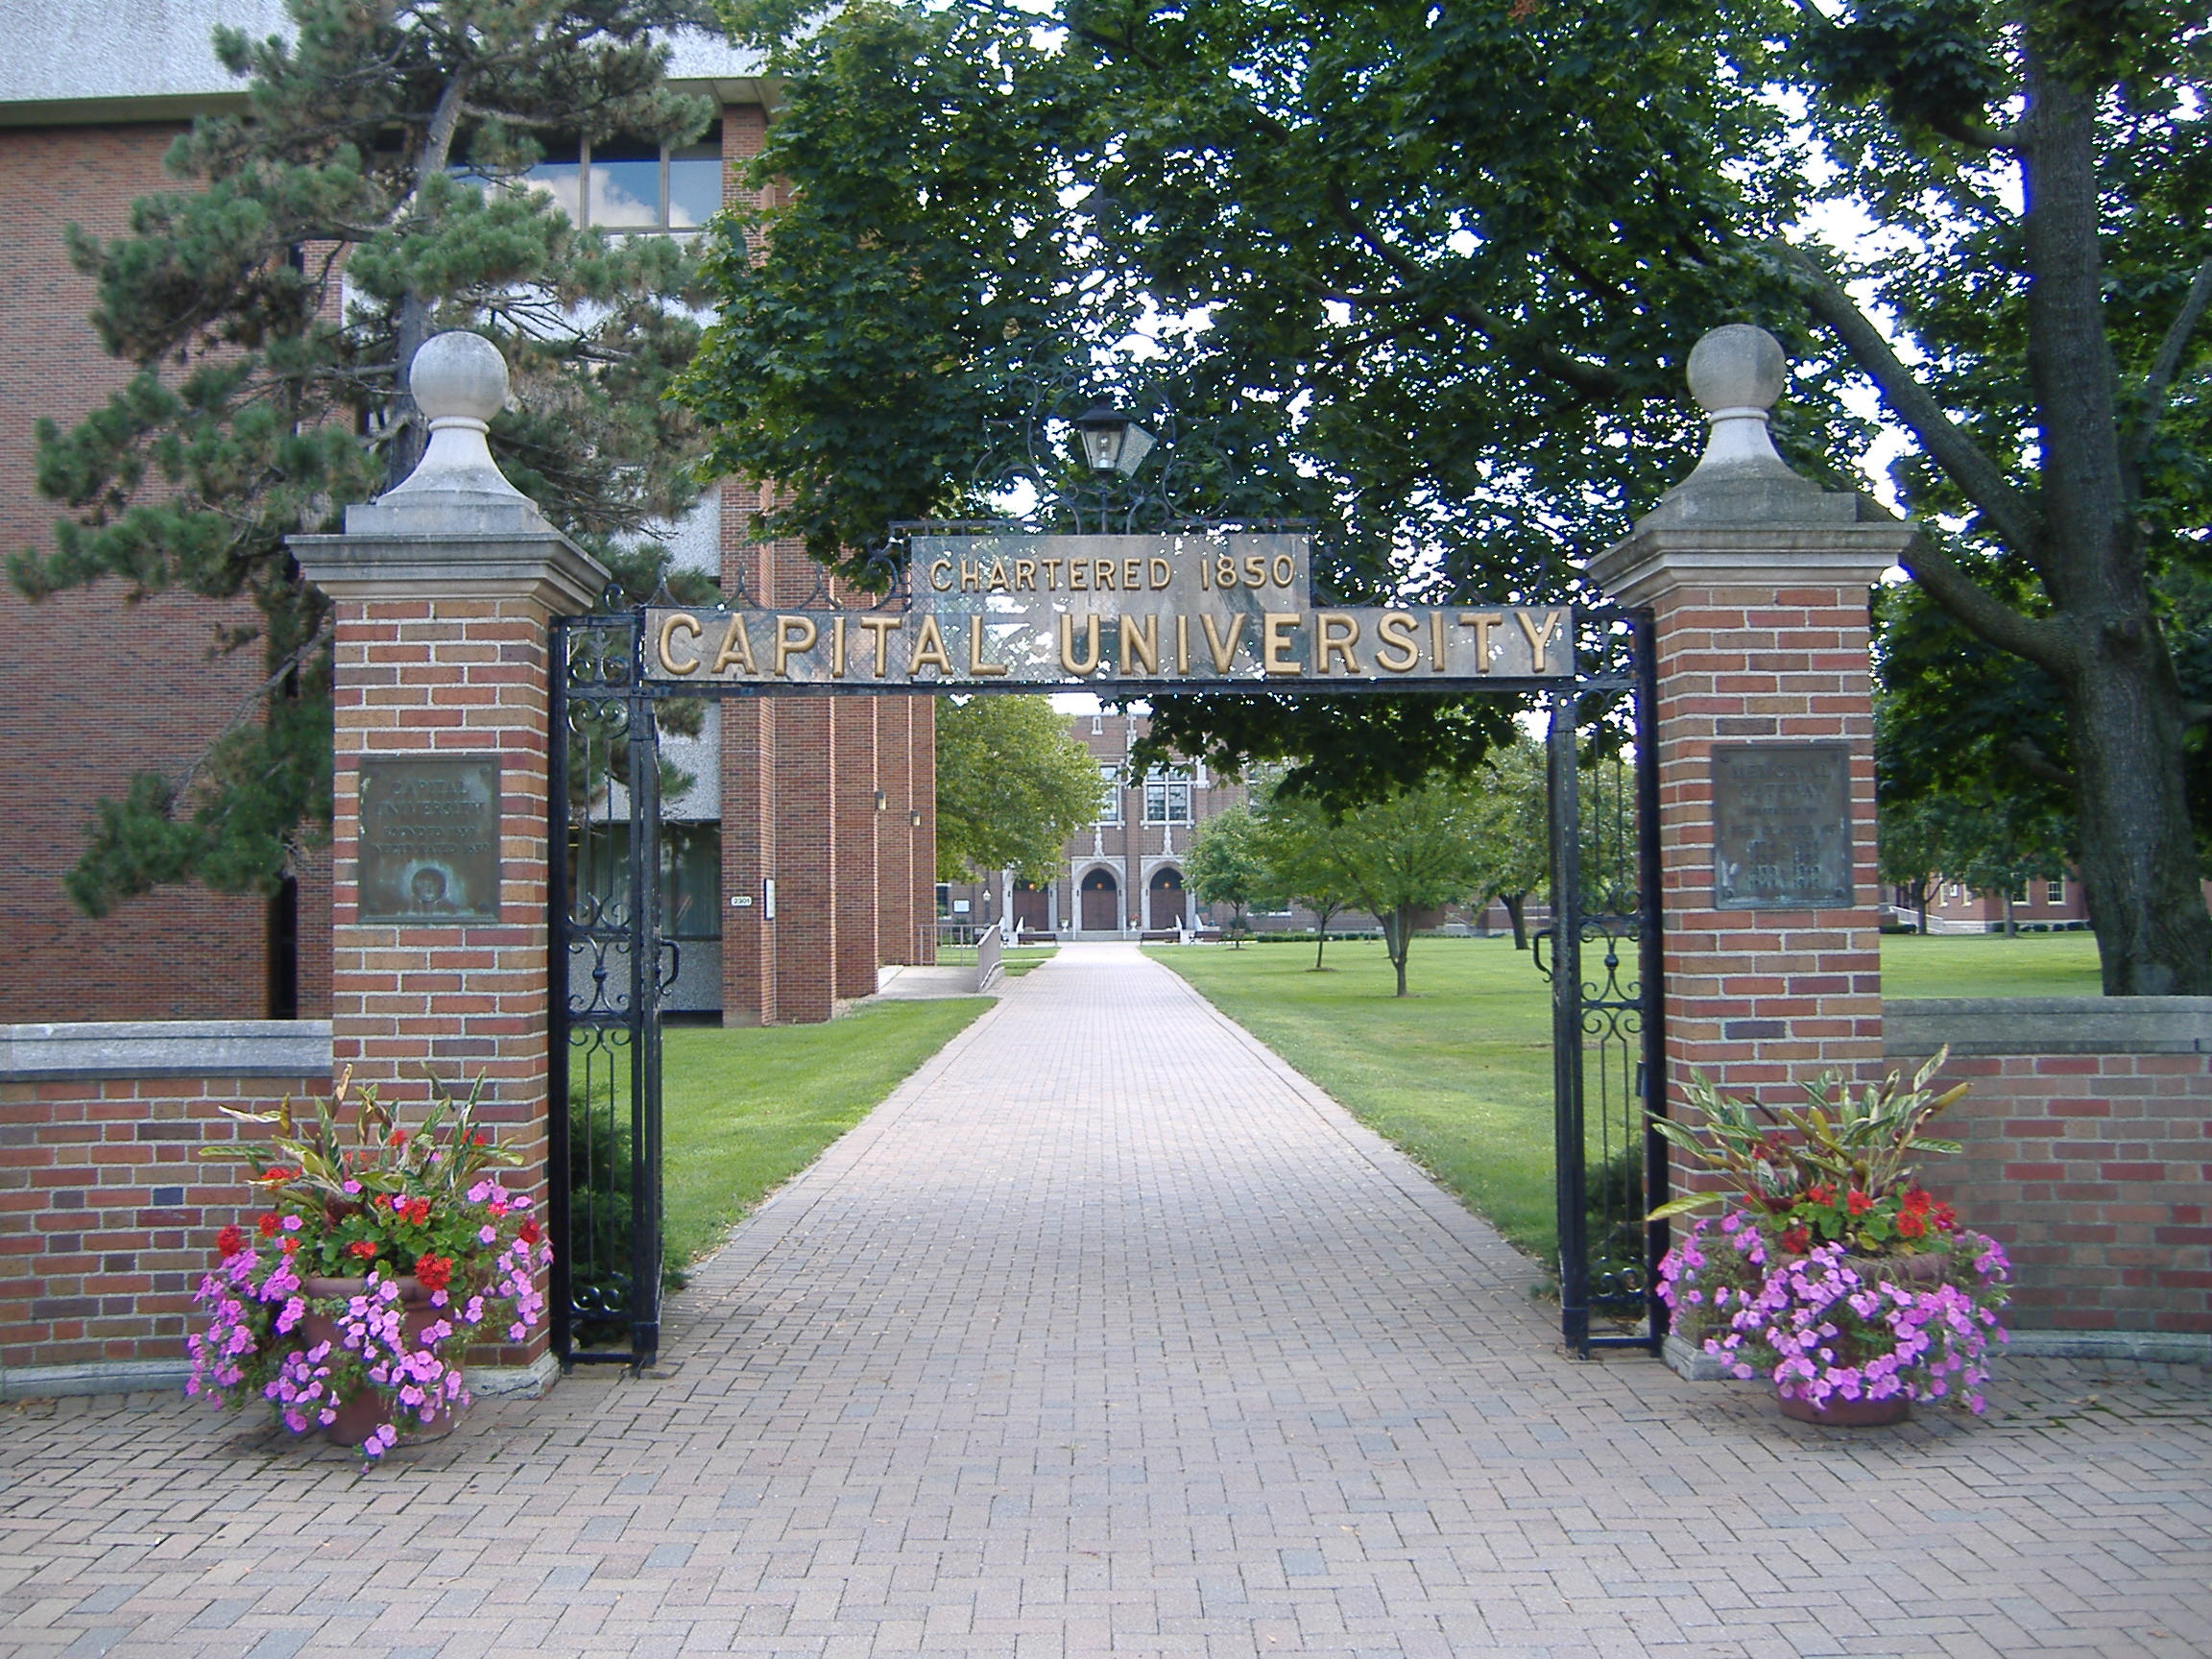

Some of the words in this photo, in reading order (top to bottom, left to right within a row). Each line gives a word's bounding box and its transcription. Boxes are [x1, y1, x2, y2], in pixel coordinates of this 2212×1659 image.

[928, 556, 1172, 592] CHARTERED
[1200, 554, 1296, 590] 1850
[658, 612, 1009, 678] CAPITAL
[1059, 611, 1561, 676] UNIVERSITY
[390, 780, 470, 796] CAPITAL
[375, 801, 486, 816] UNIVERSITY
